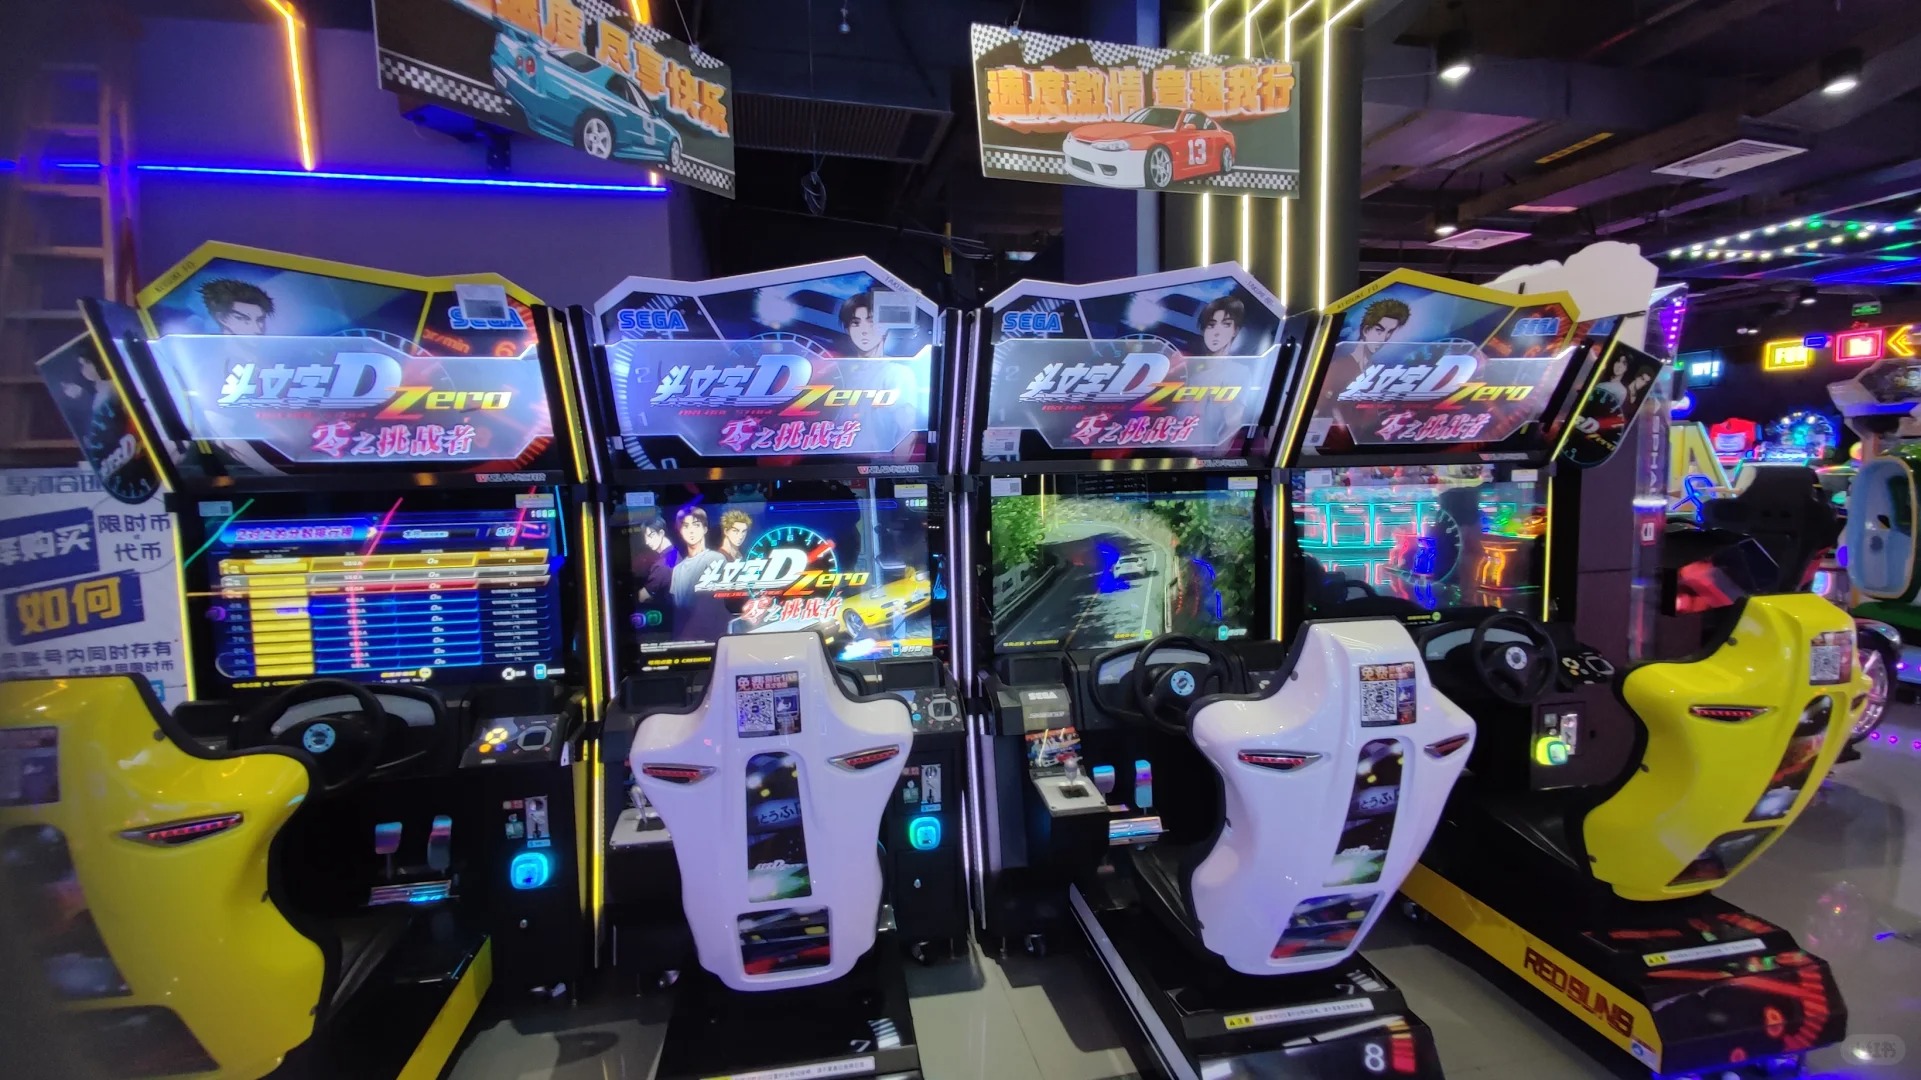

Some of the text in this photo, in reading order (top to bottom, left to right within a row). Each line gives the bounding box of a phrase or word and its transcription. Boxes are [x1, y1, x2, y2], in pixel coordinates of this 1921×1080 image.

[600, 20, 730, 137] 尽享快乐
[987, 65, 1144, 120] 速度激情
[1188, 139, 1206, 164] 13
[619, 310, 687, 331] SEGA
[1003, 312, 1062, 332] SEGA
[1511, 317, 1561, 337] SEGA
[374, 387, 512, 420] Zero
[777, 385, 898, 416] Zero
[1130, 382, 1242, 411] Zero
[1439, 382, 1534, 410] Zero
[312, 421, 476, 456] 零之挑战者
[720, 418, 860, 452] 零之挑战者
[1072, 413, 1199, 444] 零之挑战者
[1376, 411, 1491, 440] 零之挑战者
[99, 514, 170, 534] 限时币
[114, 541, 162, 562] 代币
[783, 570, 869, 596] Zero
[17, 577, 121, 636] 如何
[742, 596, 842, 623] 零之挑战者
[1364, 1043, 1386, 1072] 8
